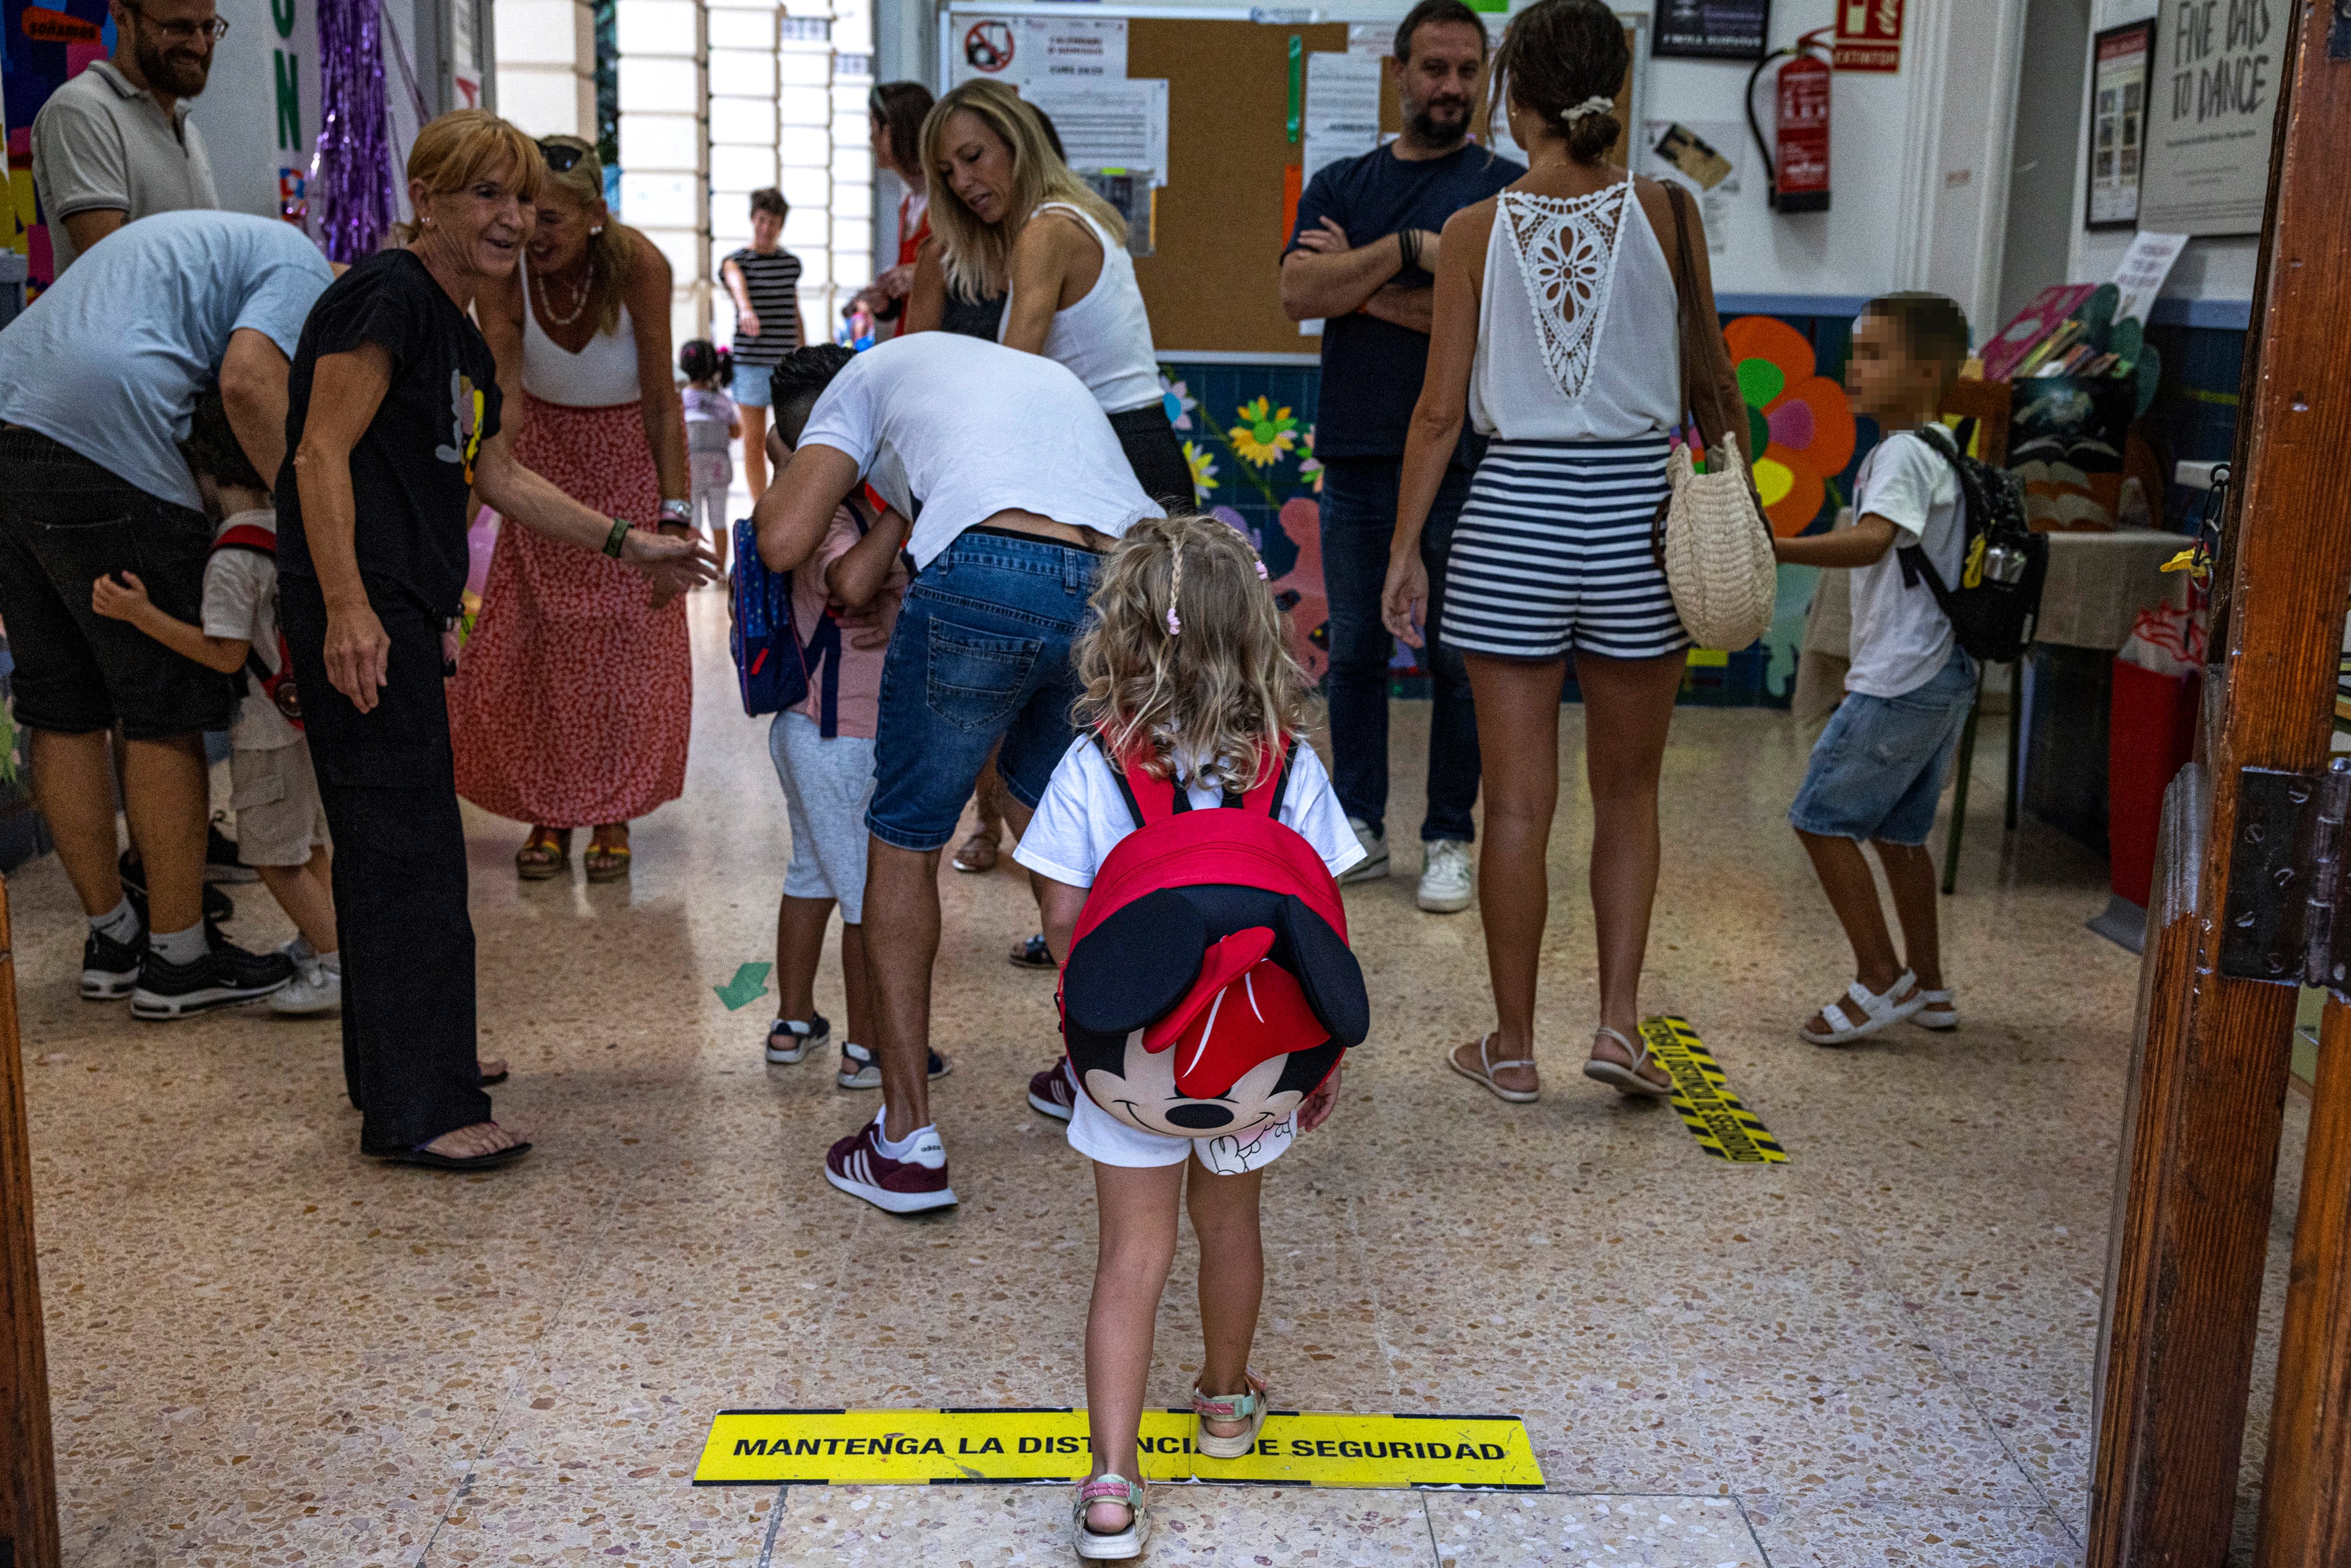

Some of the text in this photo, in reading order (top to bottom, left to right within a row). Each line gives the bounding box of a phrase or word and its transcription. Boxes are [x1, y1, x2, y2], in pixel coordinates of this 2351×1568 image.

[2175, 1, 2218, 67] FIVE
[2172, 54, 2270, 122] TO DANCE
[733, 1437, 945, 1456] MANTENGA
[958, 1437, 1004, 1454] LA
[1018, 1436, 1201, 1455] DISTNCI
[1291, 1439, 1507, 1460] SEGURIDAD
